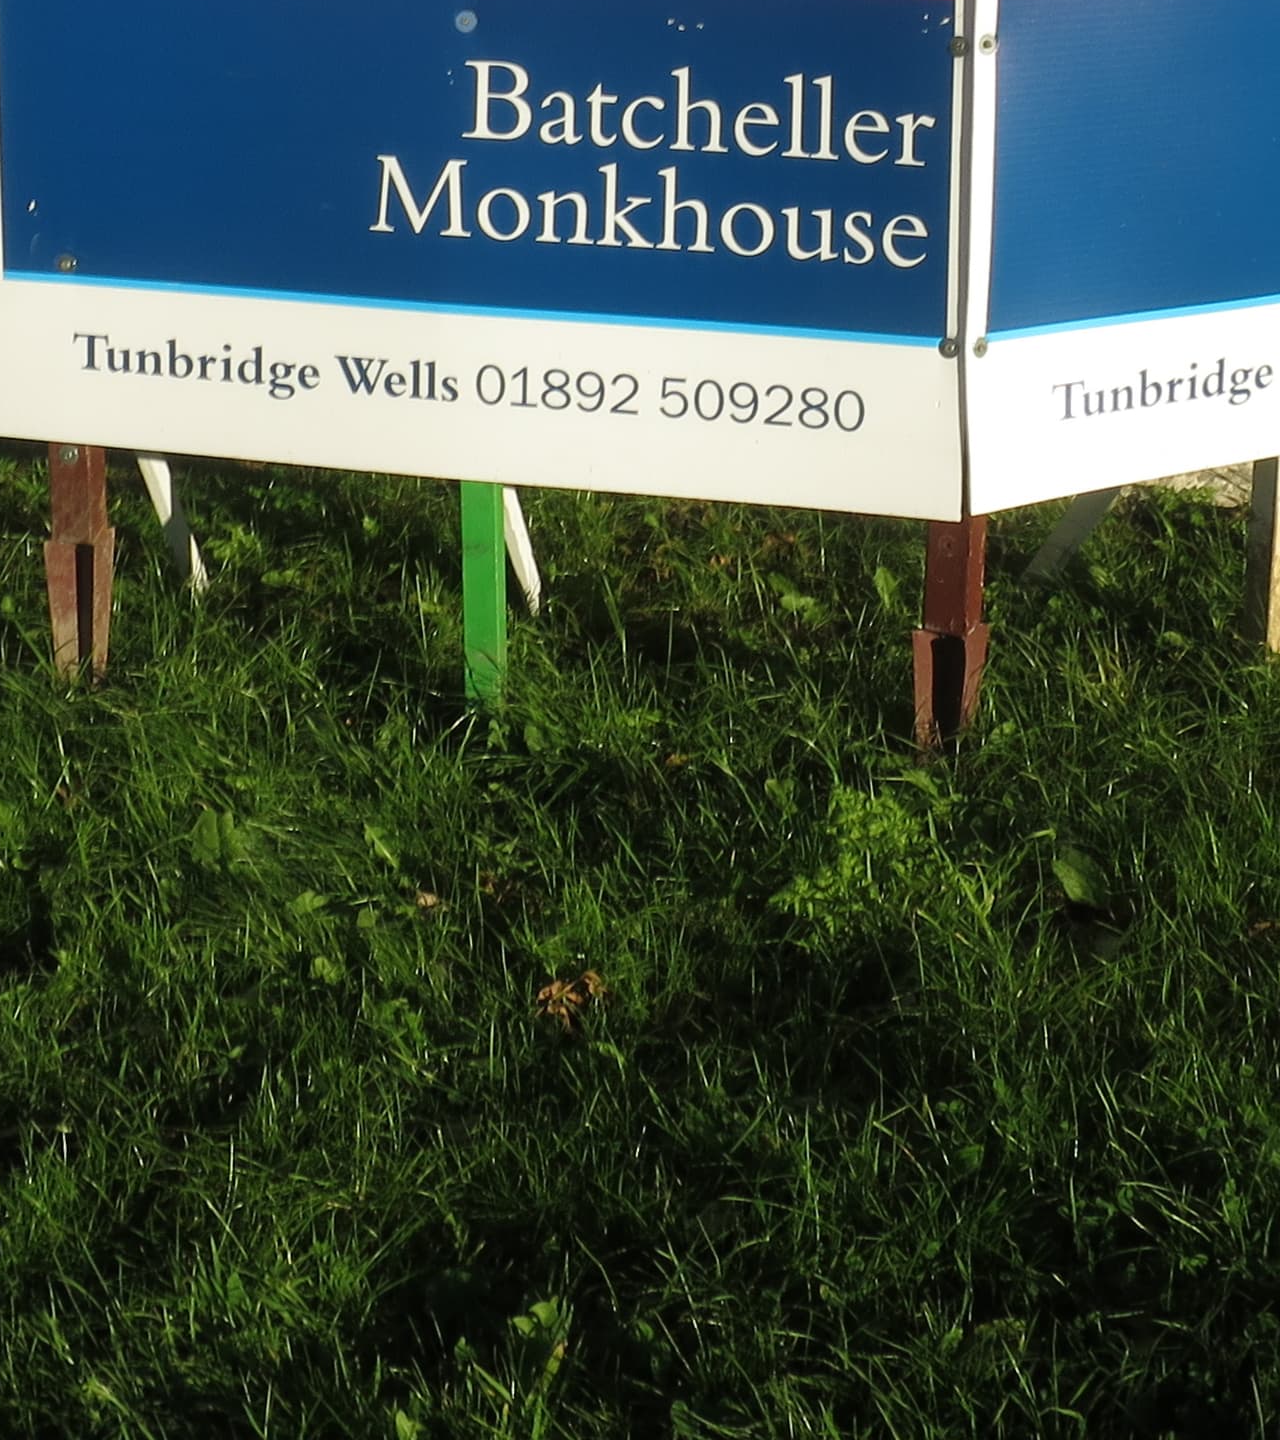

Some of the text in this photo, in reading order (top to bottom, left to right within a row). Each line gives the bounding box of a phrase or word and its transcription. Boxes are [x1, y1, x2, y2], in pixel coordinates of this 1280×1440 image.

[462, 59, 936, 167] Batcheller
[369, 154, 930, 269] Monkhouse
[72, 331, 866, 434] Tunbridge Wells 01892 509280
[1052, 358, 1274, 422] Tunbridge
